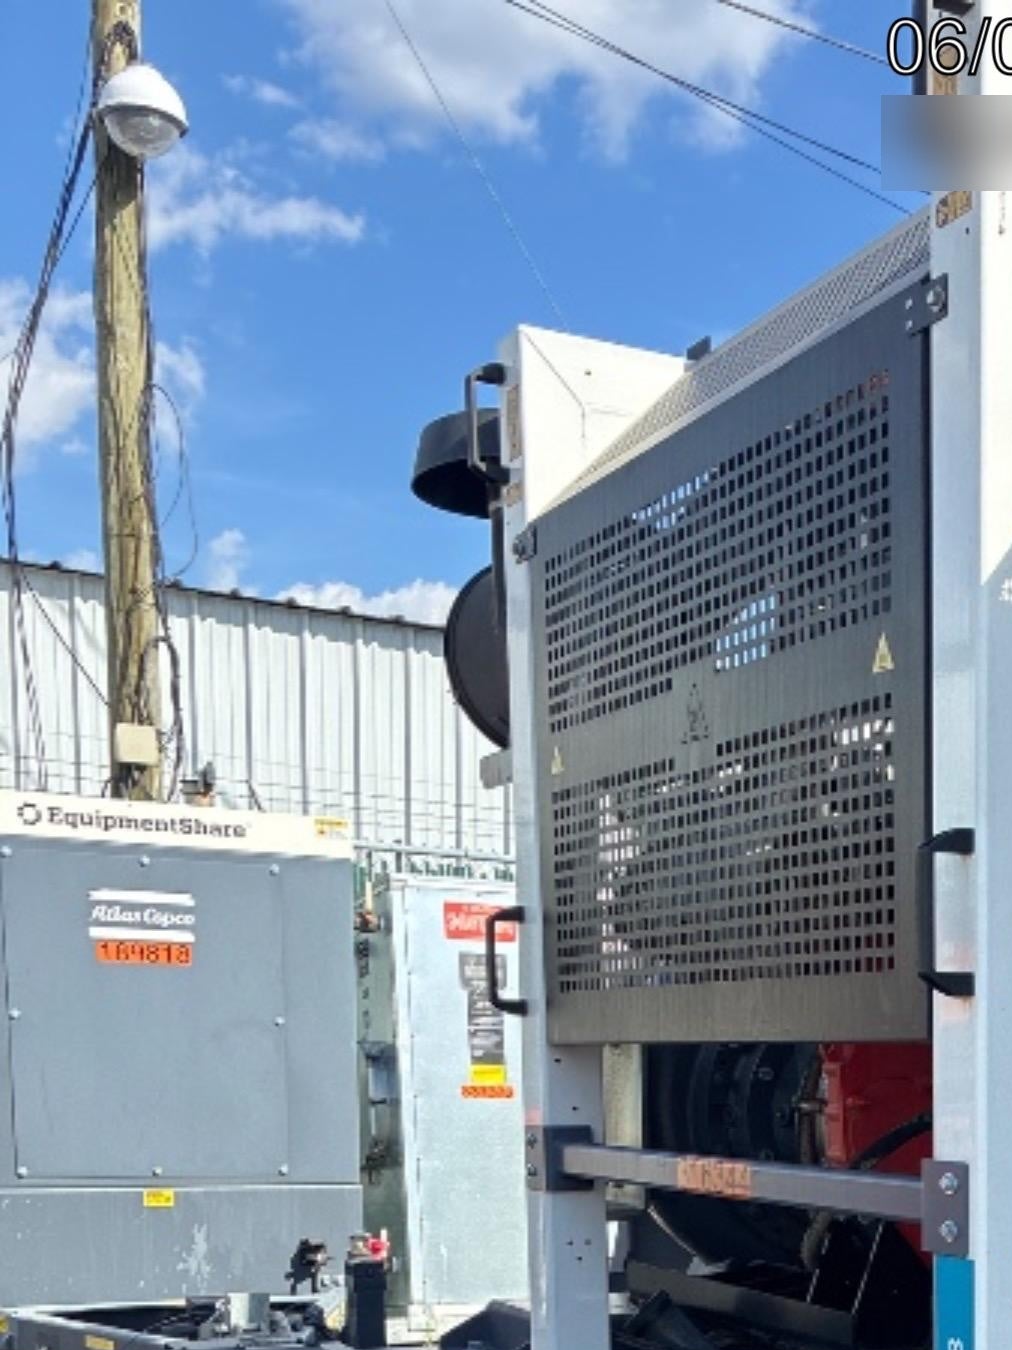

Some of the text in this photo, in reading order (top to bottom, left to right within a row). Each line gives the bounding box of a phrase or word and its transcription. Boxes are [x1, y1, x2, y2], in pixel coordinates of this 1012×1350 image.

[46, 805, 248, 839] EquipmentShare
[90, 904, 195, 928] Atlas Copco
